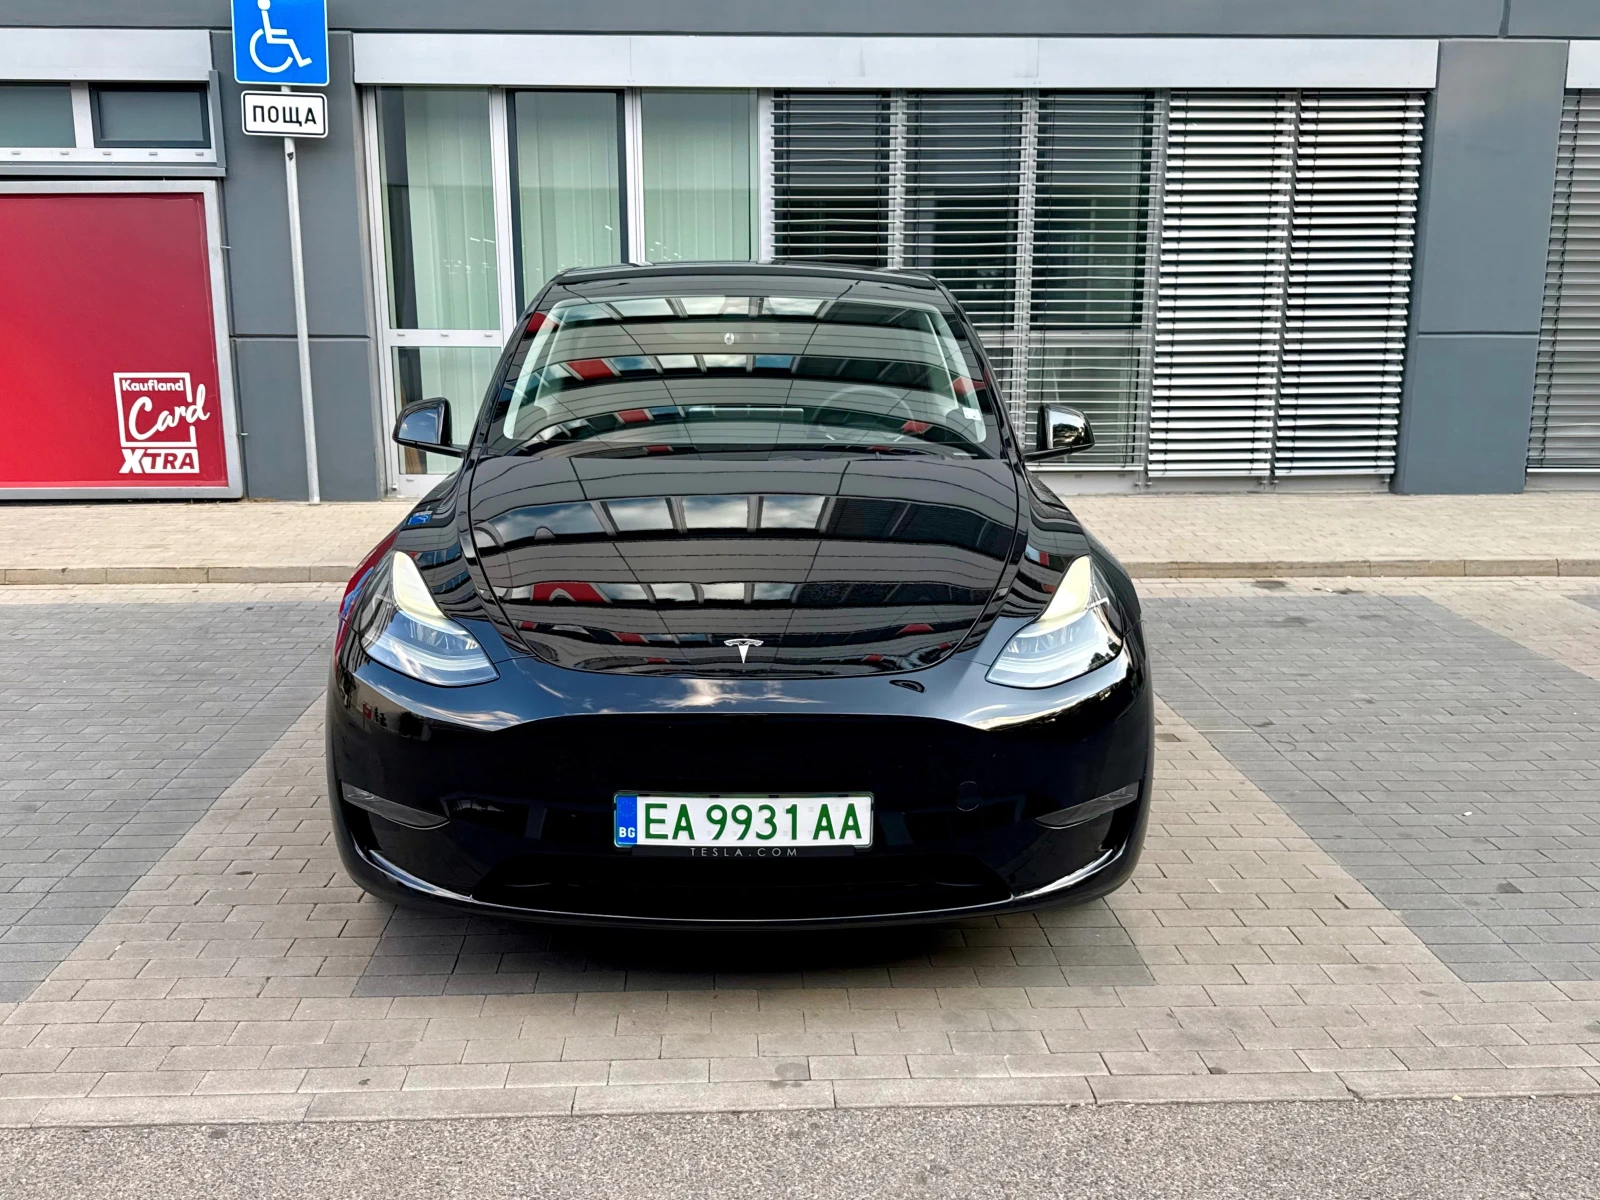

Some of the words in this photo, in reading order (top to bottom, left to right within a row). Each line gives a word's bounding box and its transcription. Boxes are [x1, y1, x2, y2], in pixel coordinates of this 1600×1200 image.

[252, 104, 317, 127] ПОЩА
[121, 379, 184, 391] Kaufland
[128, 383, 211, 440] Card
[119, 448, 195, 474] XTRA
[618, 826, 636, 838] BG
[644, 802, 695, 840] EA
[706, 803, 798, 840] 9931
[812, 802, 862, 840] AA
[690, 847, 798, 857] TESLA.COM
